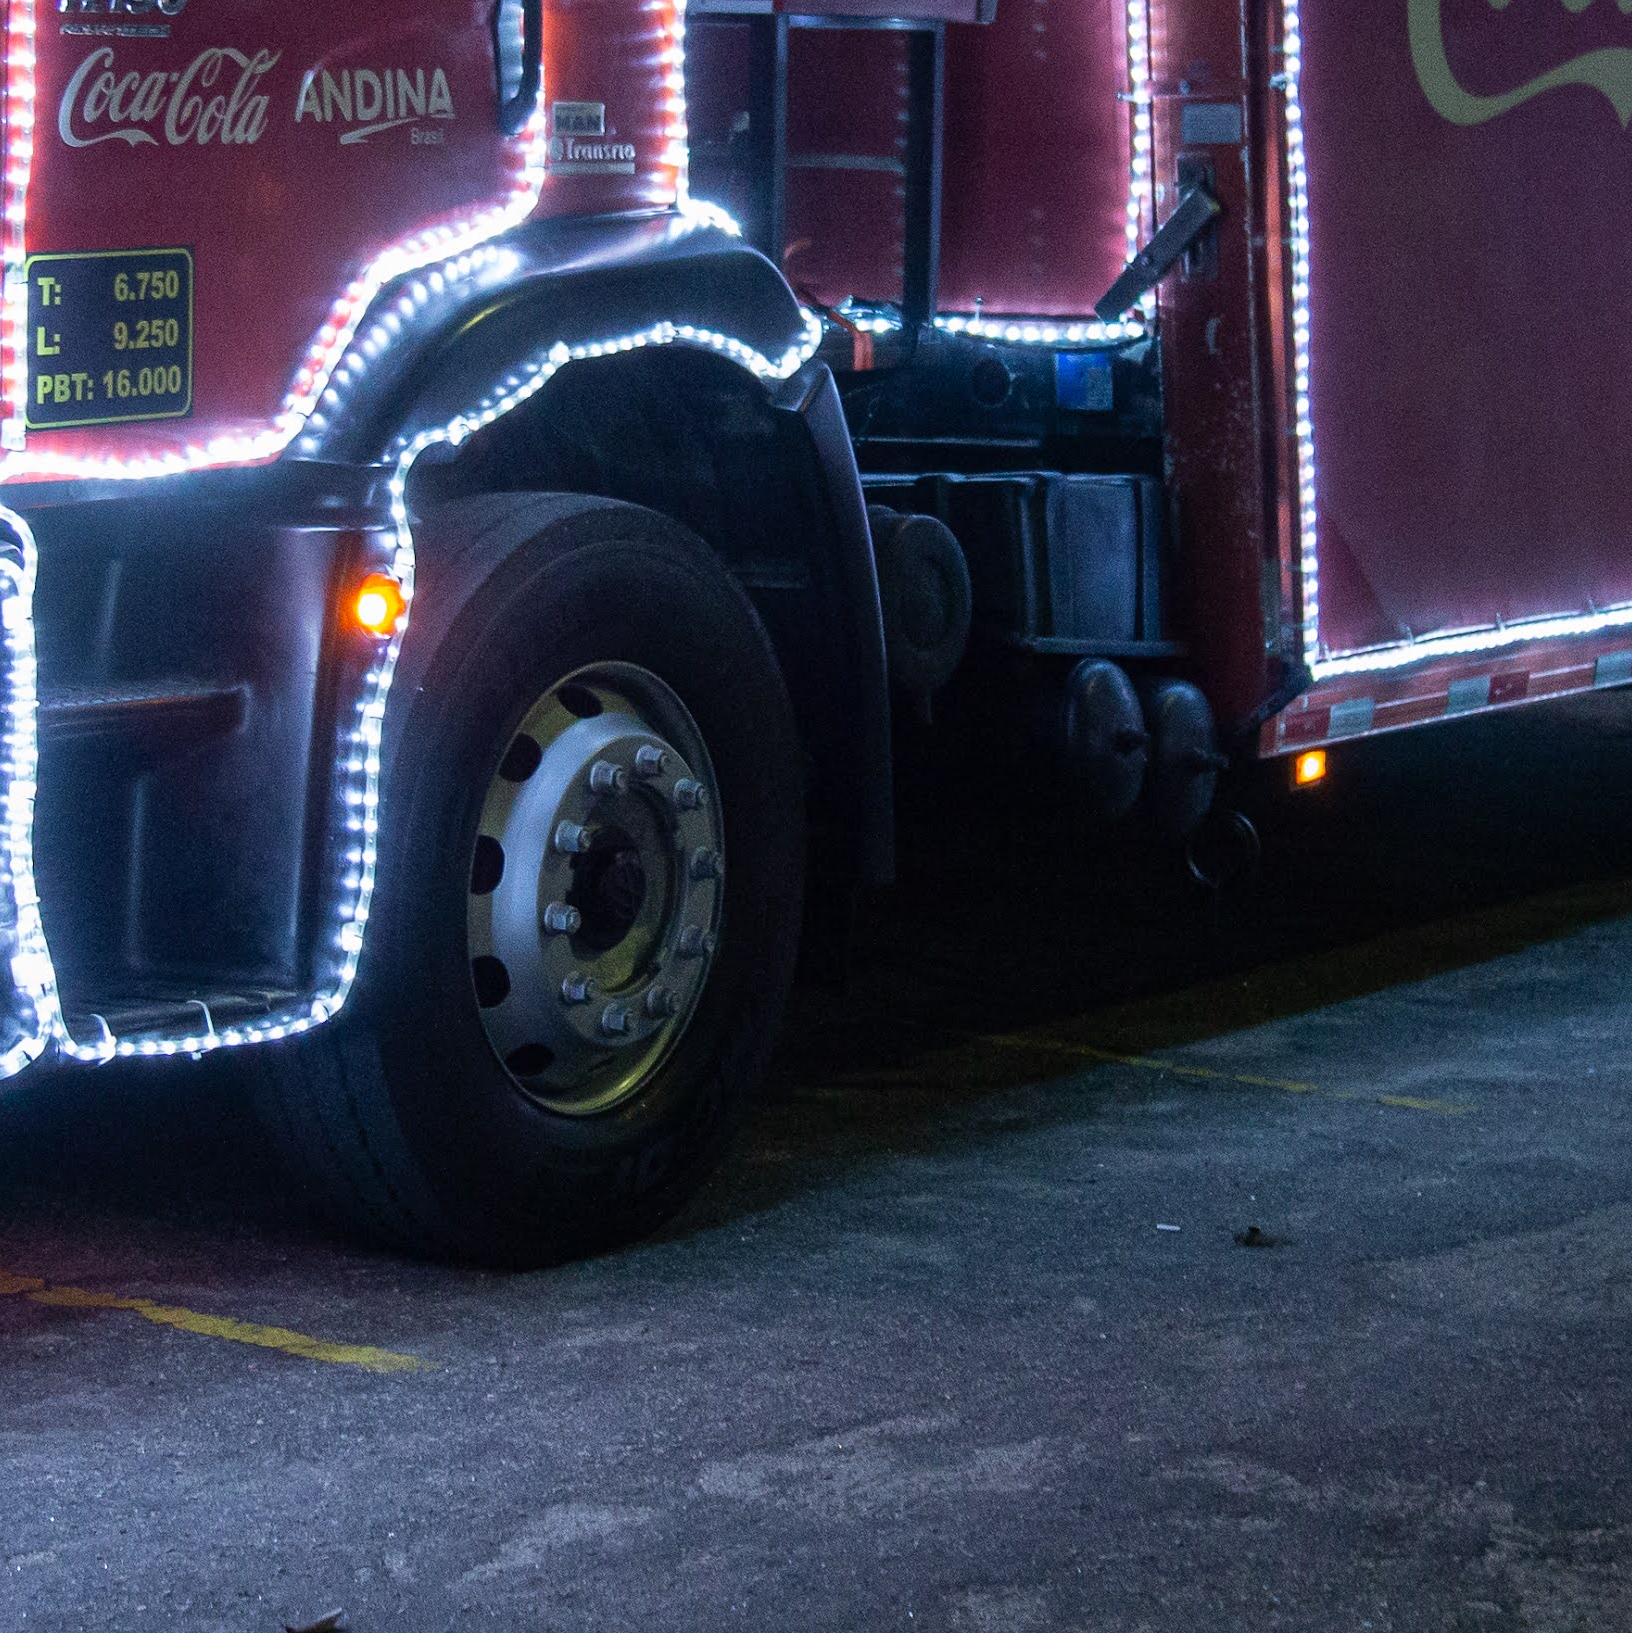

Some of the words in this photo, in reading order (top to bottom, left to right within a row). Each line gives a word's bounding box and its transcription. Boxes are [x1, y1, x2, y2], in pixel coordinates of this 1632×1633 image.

[58, 46, 285, 148] Coca-Cola
[295, 68, 456, 123] ANDINA
[411, 127, 445, 145] Brasil
[37, 277, 62, 306] T:
[114, 270, 180, 302] 6.750
[36, 326, 61, 356] L:
[113, 318, 179, 350] 9.250
[37, 373, 95, 404] PBT:
[102, 365, 181, 399] 16.000
